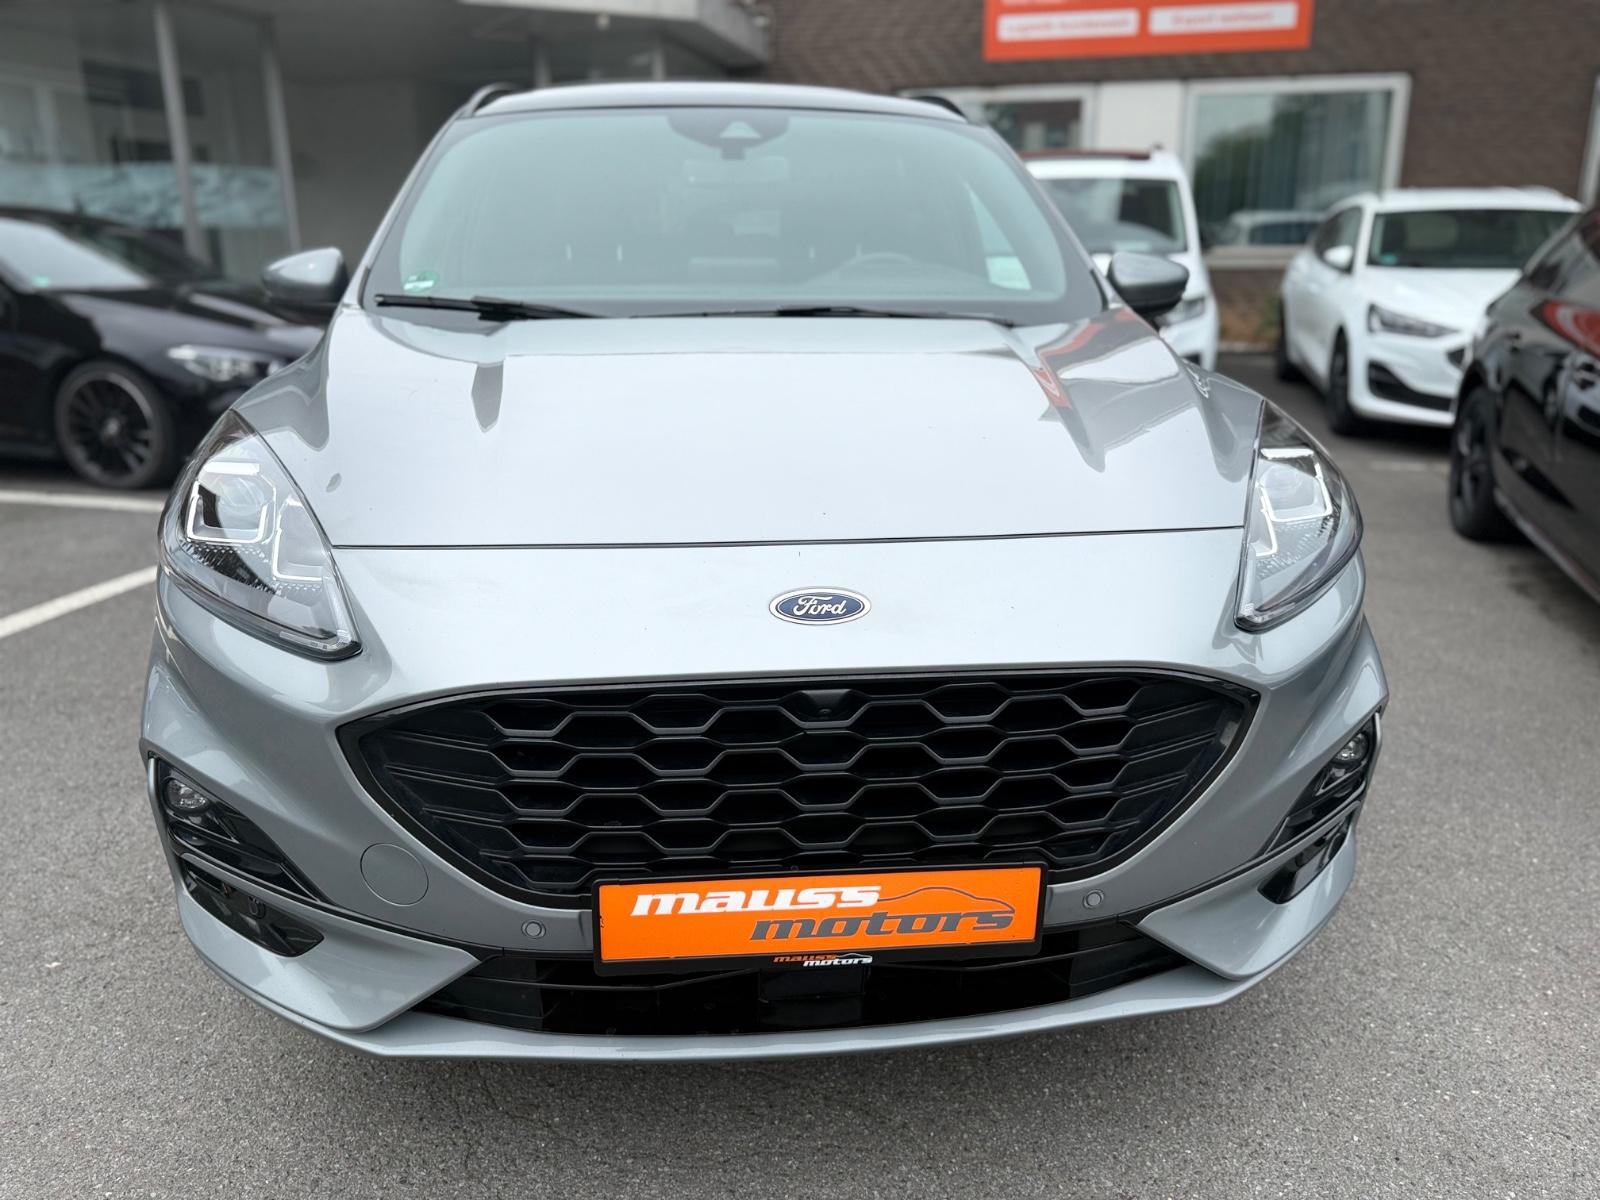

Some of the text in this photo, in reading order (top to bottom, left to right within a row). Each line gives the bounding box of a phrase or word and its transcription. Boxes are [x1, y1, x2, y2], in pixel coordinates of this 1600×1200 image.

[793, 595, 847, 616] Ford
[630, 886, 881, 916] mauss
[750, 911, 1015, 941] motors
[773, 953, 838, 963] mauss
[803, 956, 873, 967] motors
